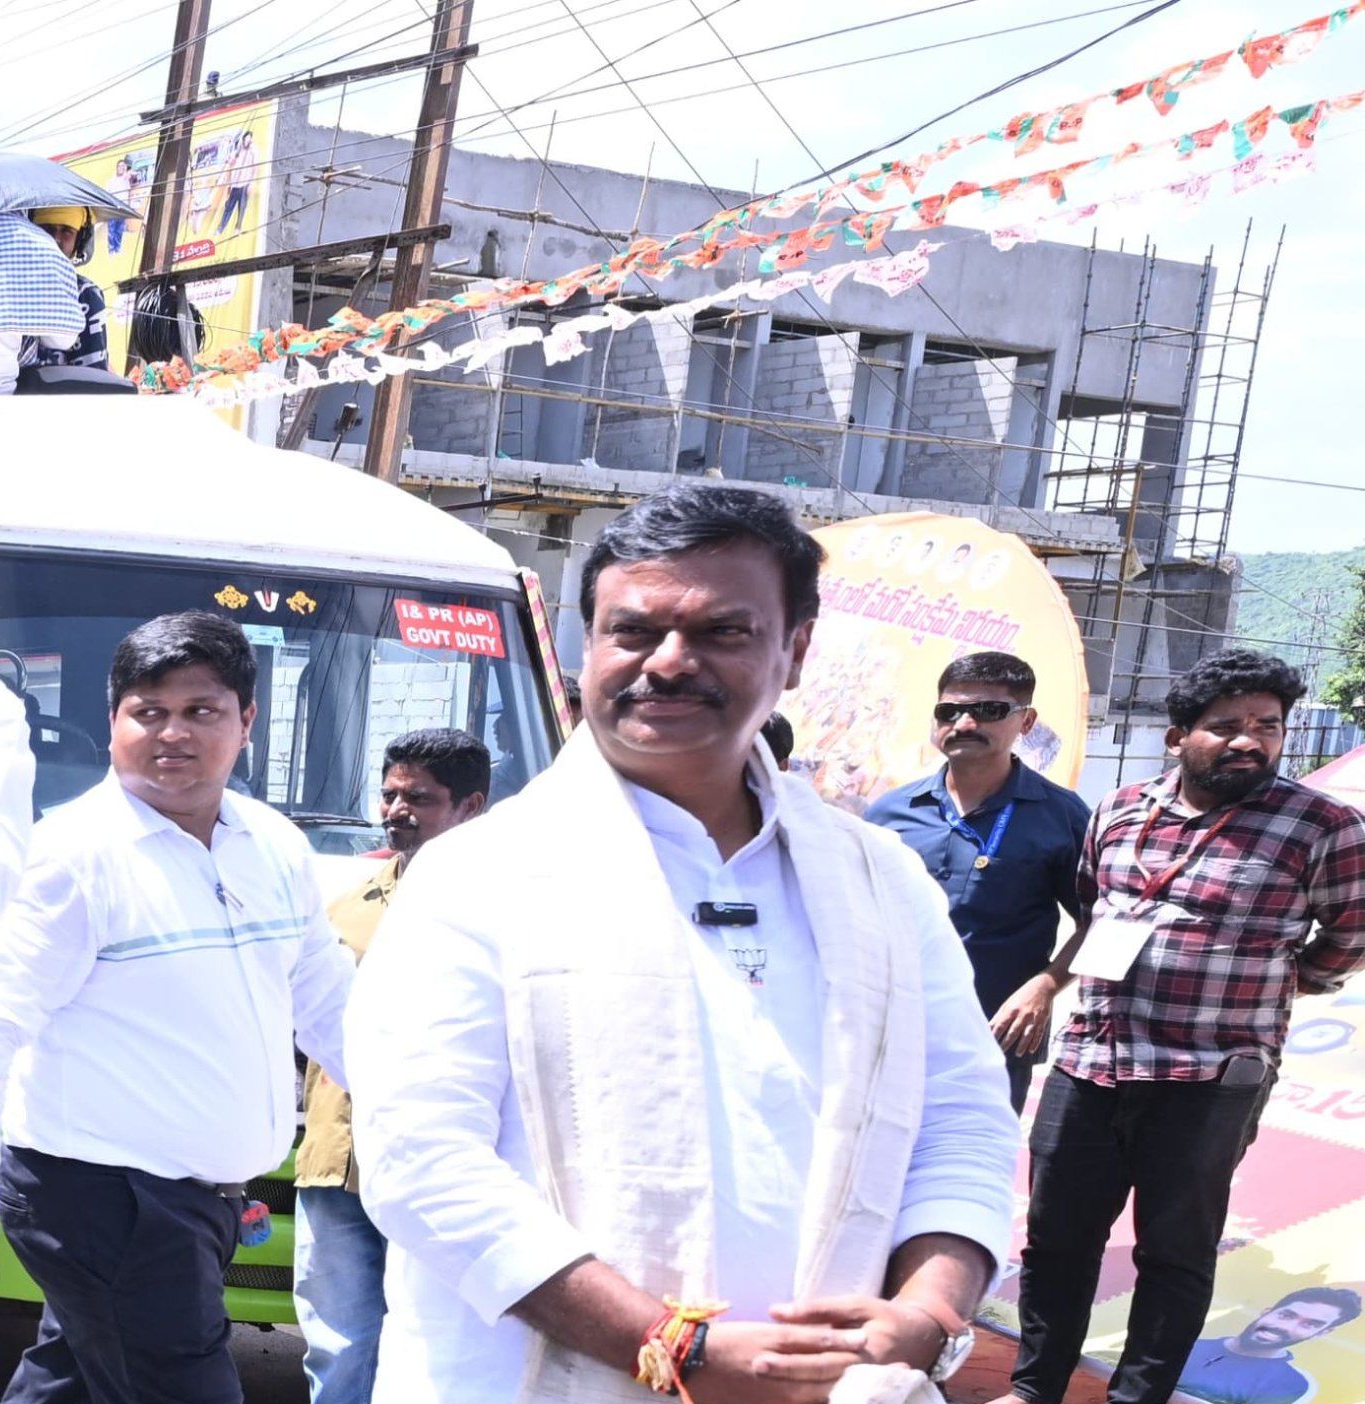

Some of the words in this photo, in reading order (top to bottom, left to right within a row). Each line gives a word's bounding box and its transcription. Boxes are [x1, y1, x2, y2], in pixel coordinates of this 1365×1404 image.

[428, 607, 454, 622] PR
[458, 610, 494, 632] (AP)
[406, 626, 451, 646] GOVT
[454, 631, 496, 652] DUTY
